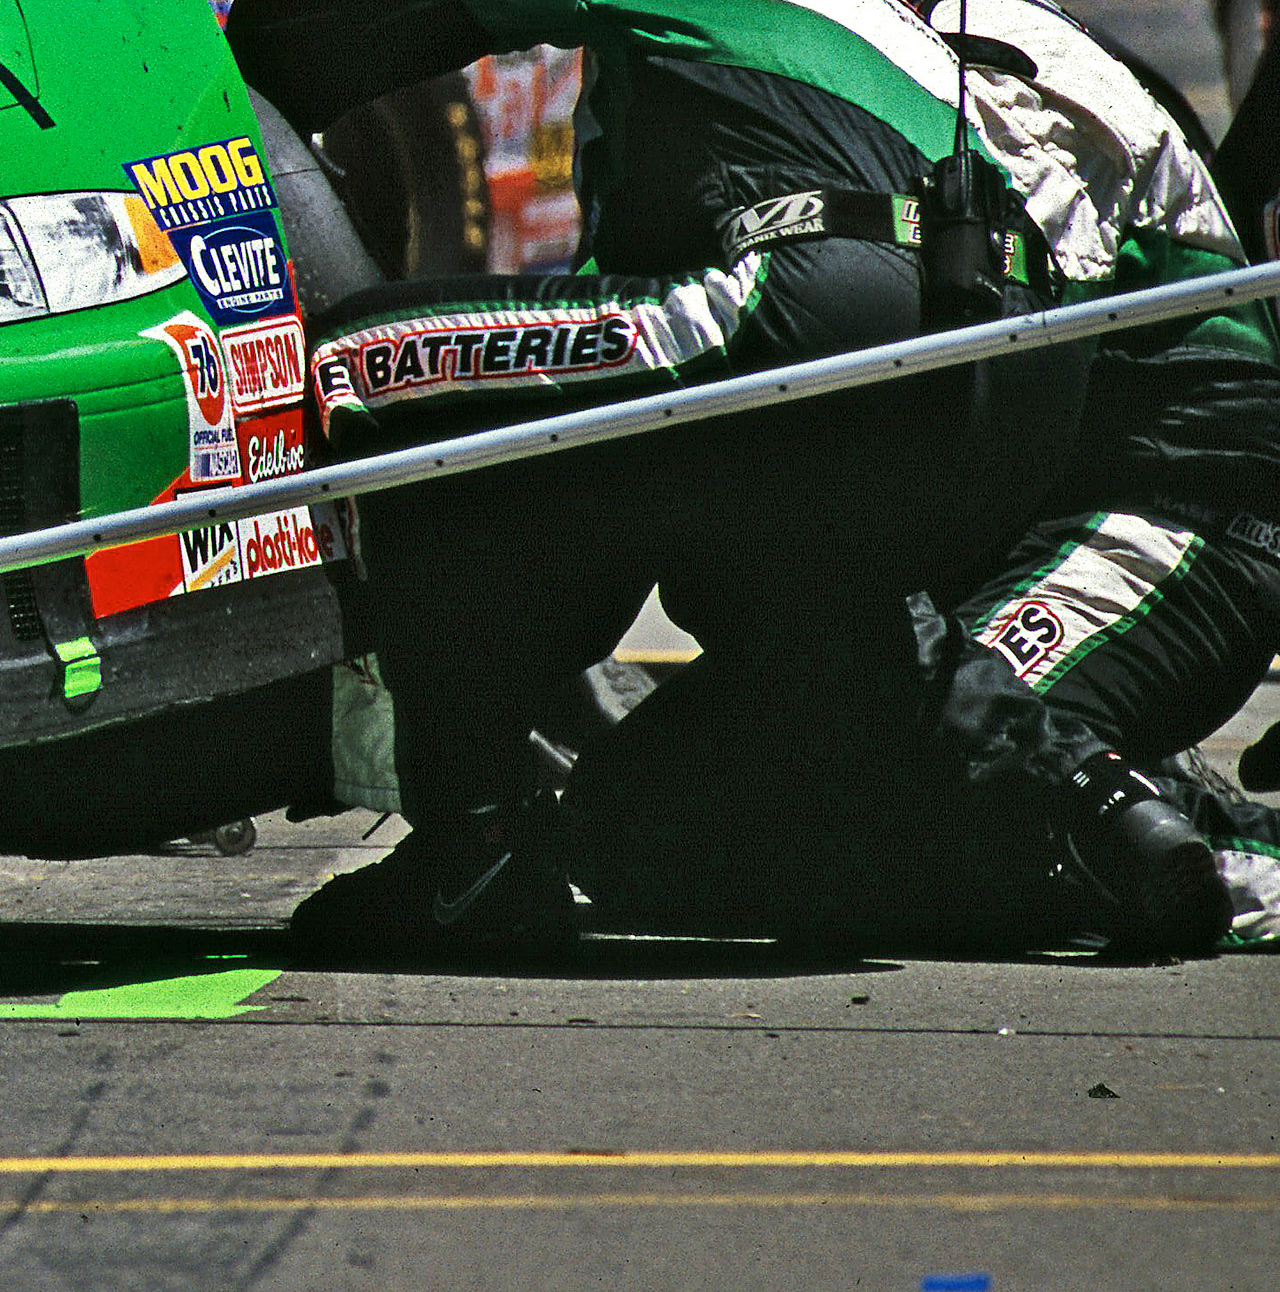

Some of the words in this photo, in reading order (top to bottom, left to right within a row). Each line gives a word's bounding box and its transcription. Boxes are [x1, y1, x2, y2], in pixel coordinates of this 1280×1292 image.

[131, 137, 265, 210] MOOG
[778, 217, 826, 237] WEAR
[190, 234, 281, 297] CLEVITE
[190, 335, 220, 395] 76
[229, 331, 303, 397] SIMPSON
[364, 317, 632, 391] BATTERIES
[997, 606, 1058, 667] ES
